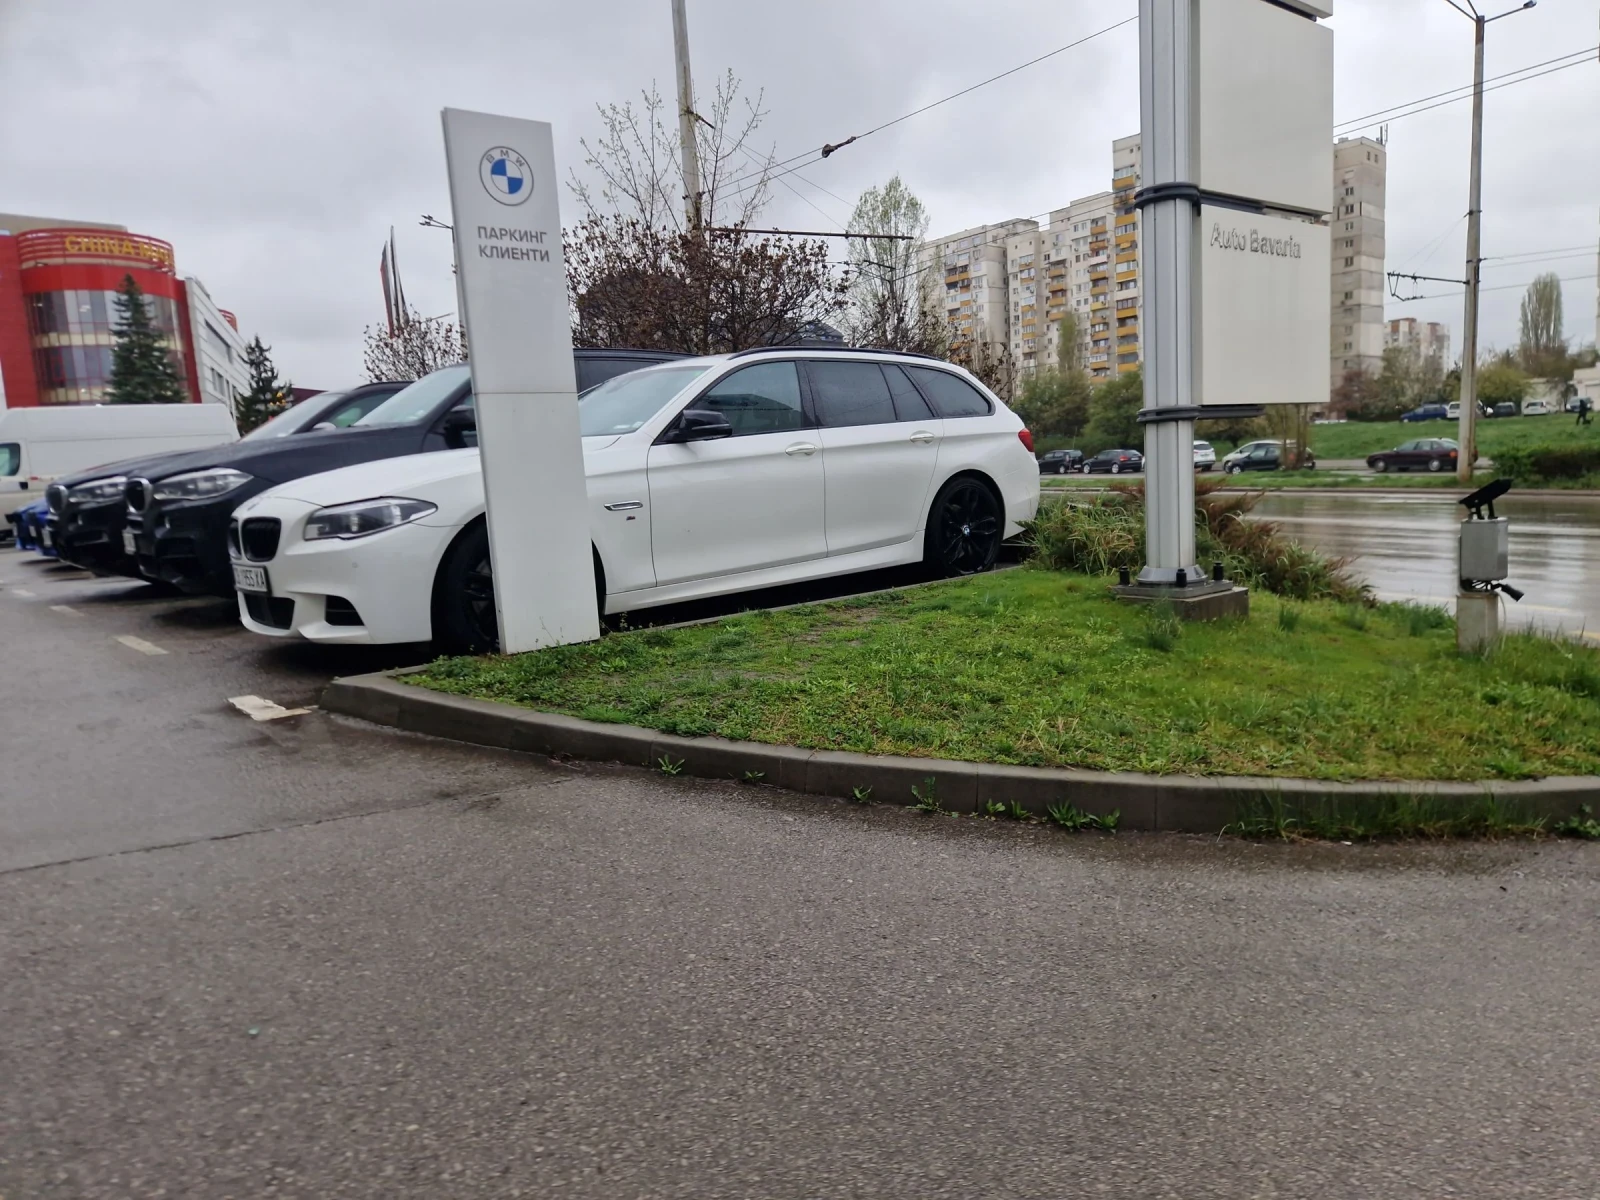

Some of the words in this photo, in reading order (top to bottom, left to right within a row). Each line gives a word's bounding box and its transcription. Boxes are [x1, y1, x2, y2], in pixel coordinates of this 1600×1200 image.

[485, 149, 525, 168] BMW
[477, 225, 548, 245] ПАРКИНГ
[1210, 222, 1247, 251] Auto
[1249, 228, 1301, 259] Bavaria
[65, 235, 135, 257] CHINA
[478, 244, 551, 263] КЛИЕНТИ
